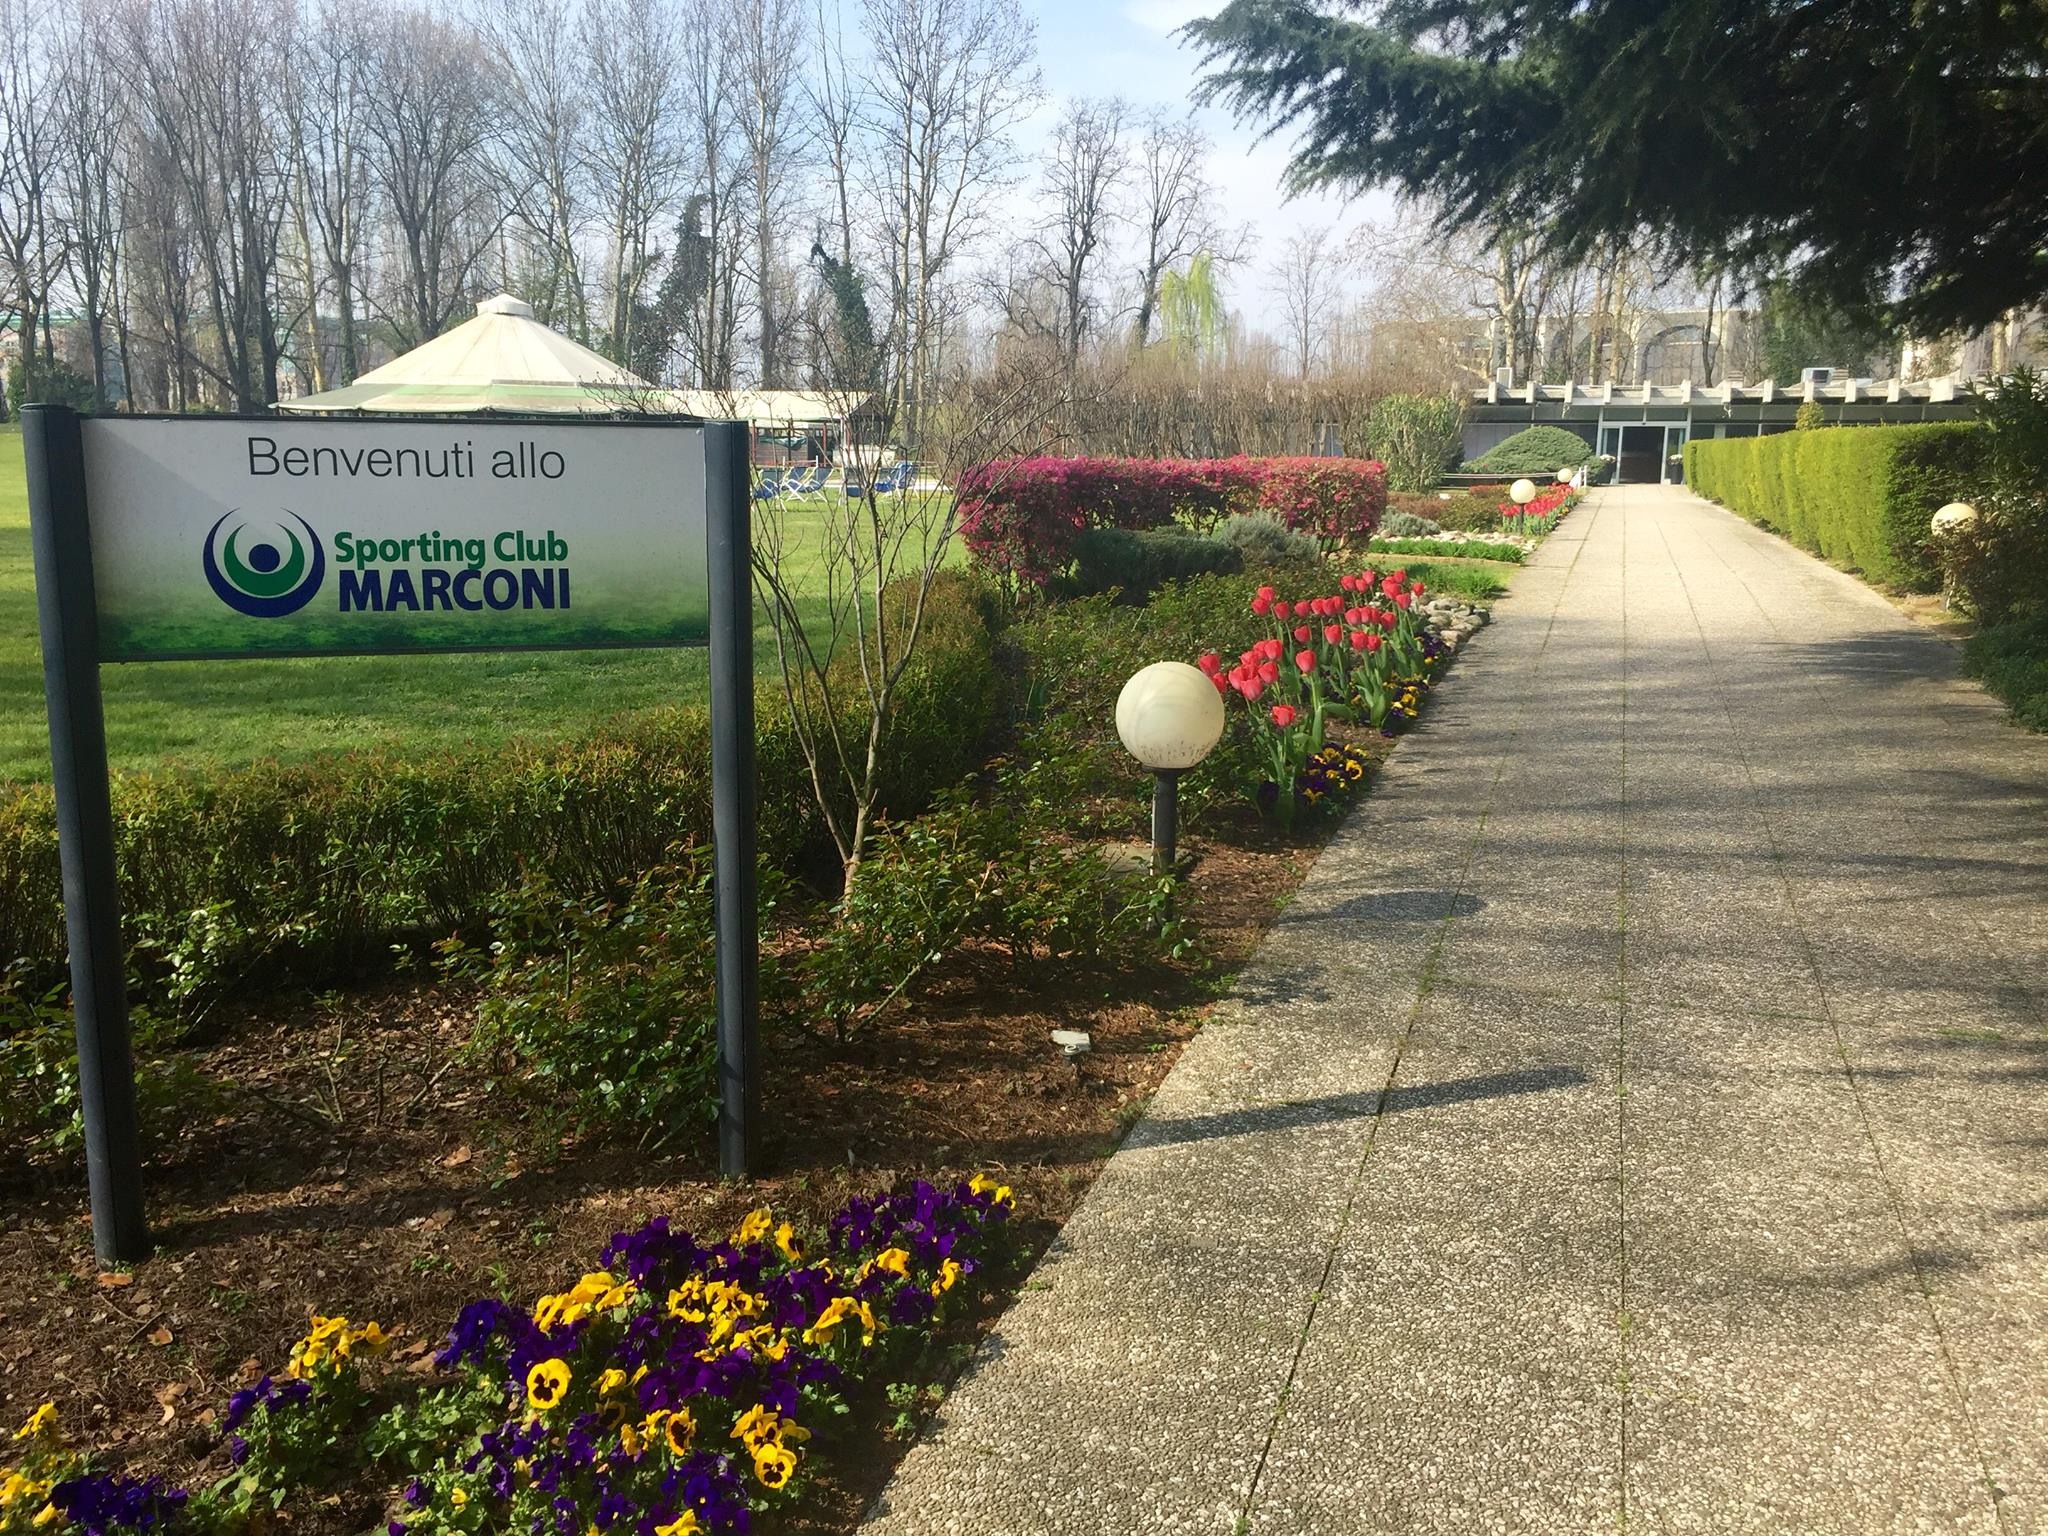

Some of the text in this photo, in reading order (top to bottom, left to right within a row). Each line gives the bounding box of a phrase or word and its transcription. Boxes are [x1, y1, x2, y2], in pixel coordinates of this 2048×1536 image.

[247, 436, 566, 480] Benvenuti allo
[333, 530, 569, 571] Sporting Club
[338, 567, 571, 613] MARCONI
